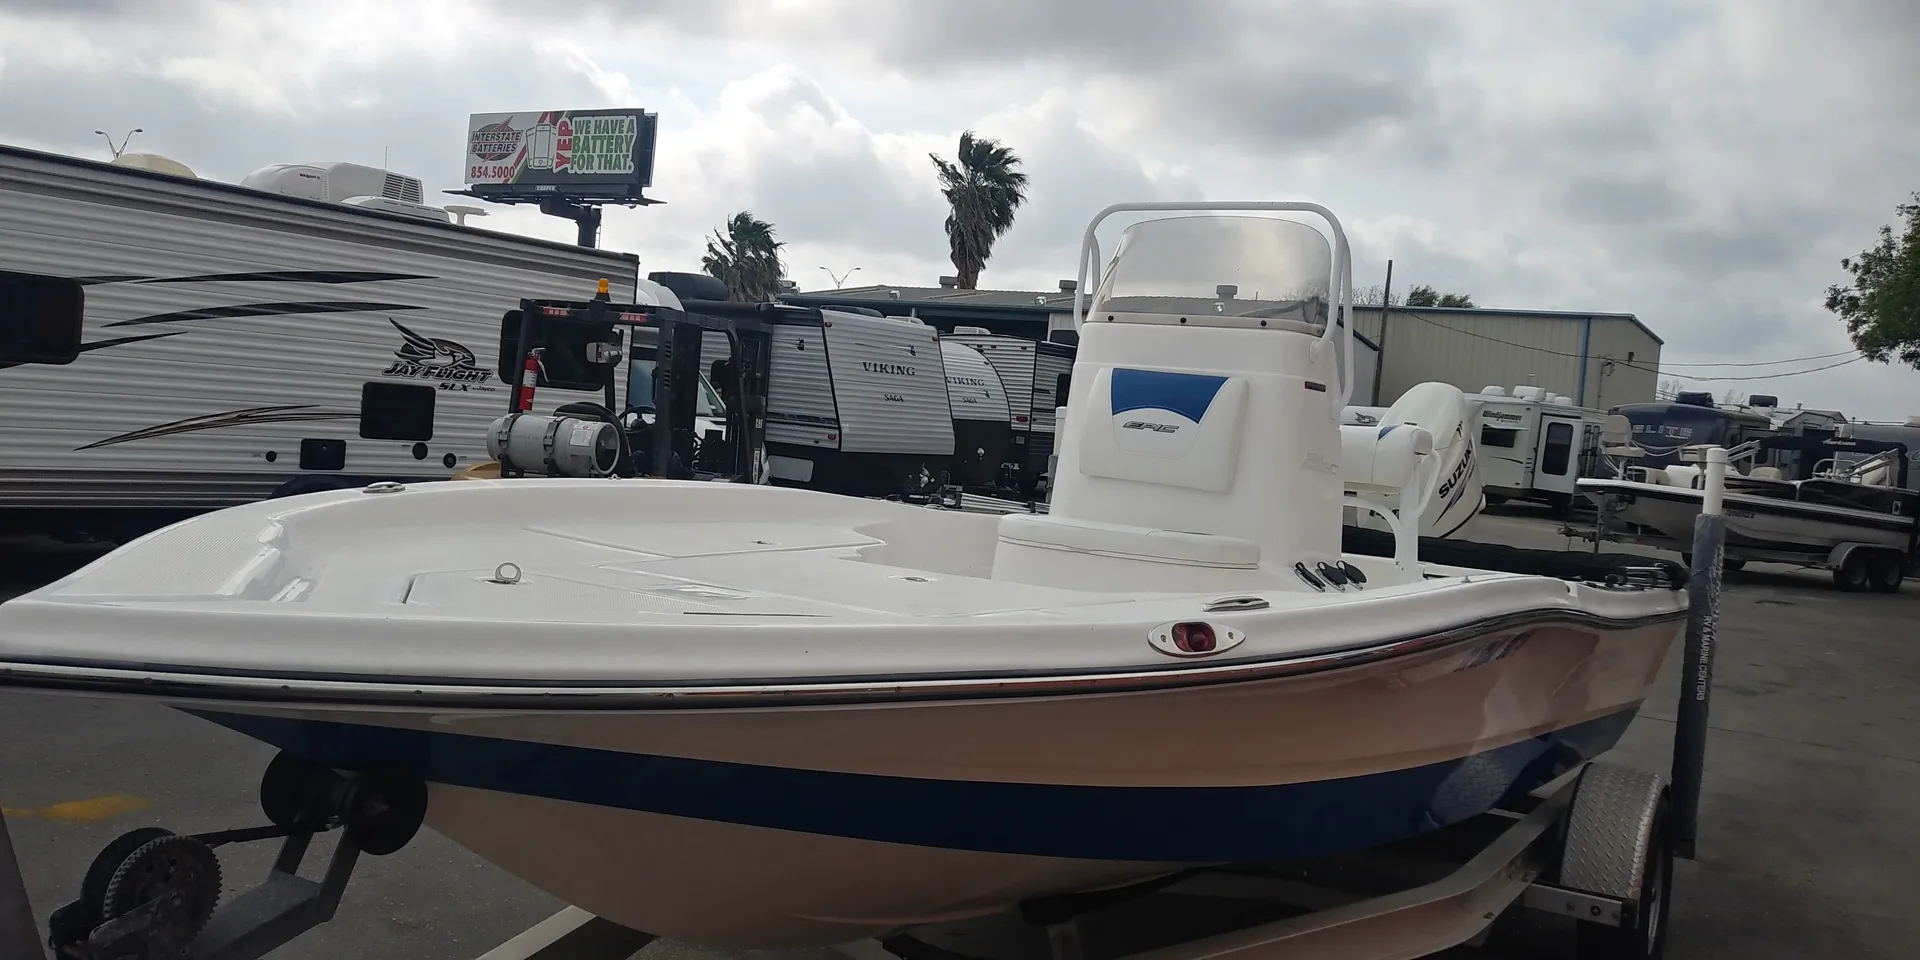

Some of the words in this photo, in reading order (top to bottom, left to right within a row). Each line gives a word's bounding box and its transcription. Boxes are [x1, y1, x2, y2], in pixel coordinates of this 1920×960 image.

[573, 119, 594, 135] WE
[594, 118, 625, 135] HAVE
[625, 118, 635, 134] A
[471, 131, 523, 143] INTERSTATE
[571, 134, 635, 154] BATTERY
[471, 142, 517, 154] BATTERIES
[554, 120, 574, 169] YEP
[570, 155, 595, 171] FOR
[595, 153, 633, 171] THAT.
[470, 165, 515, 179] 854.5000
[382, 361, 421, 377] JAY
[422, 366, 494, 383] FLIGHT
[862, 361, 916, 376] VIKING
[438, 383, 471, 391] SLX
[945, 376, 985, 387] VIKING
[884, 393, 904, 402] SAGA
[1122, 420, 1180, 433] EPIC
[1632, 424, 1693, 437] ELITE
[1703, 615, 1713, 627] RV
[1700, 635, 1711, 664] MARINE
[1696, 664, 1708, 701] CENTERS
